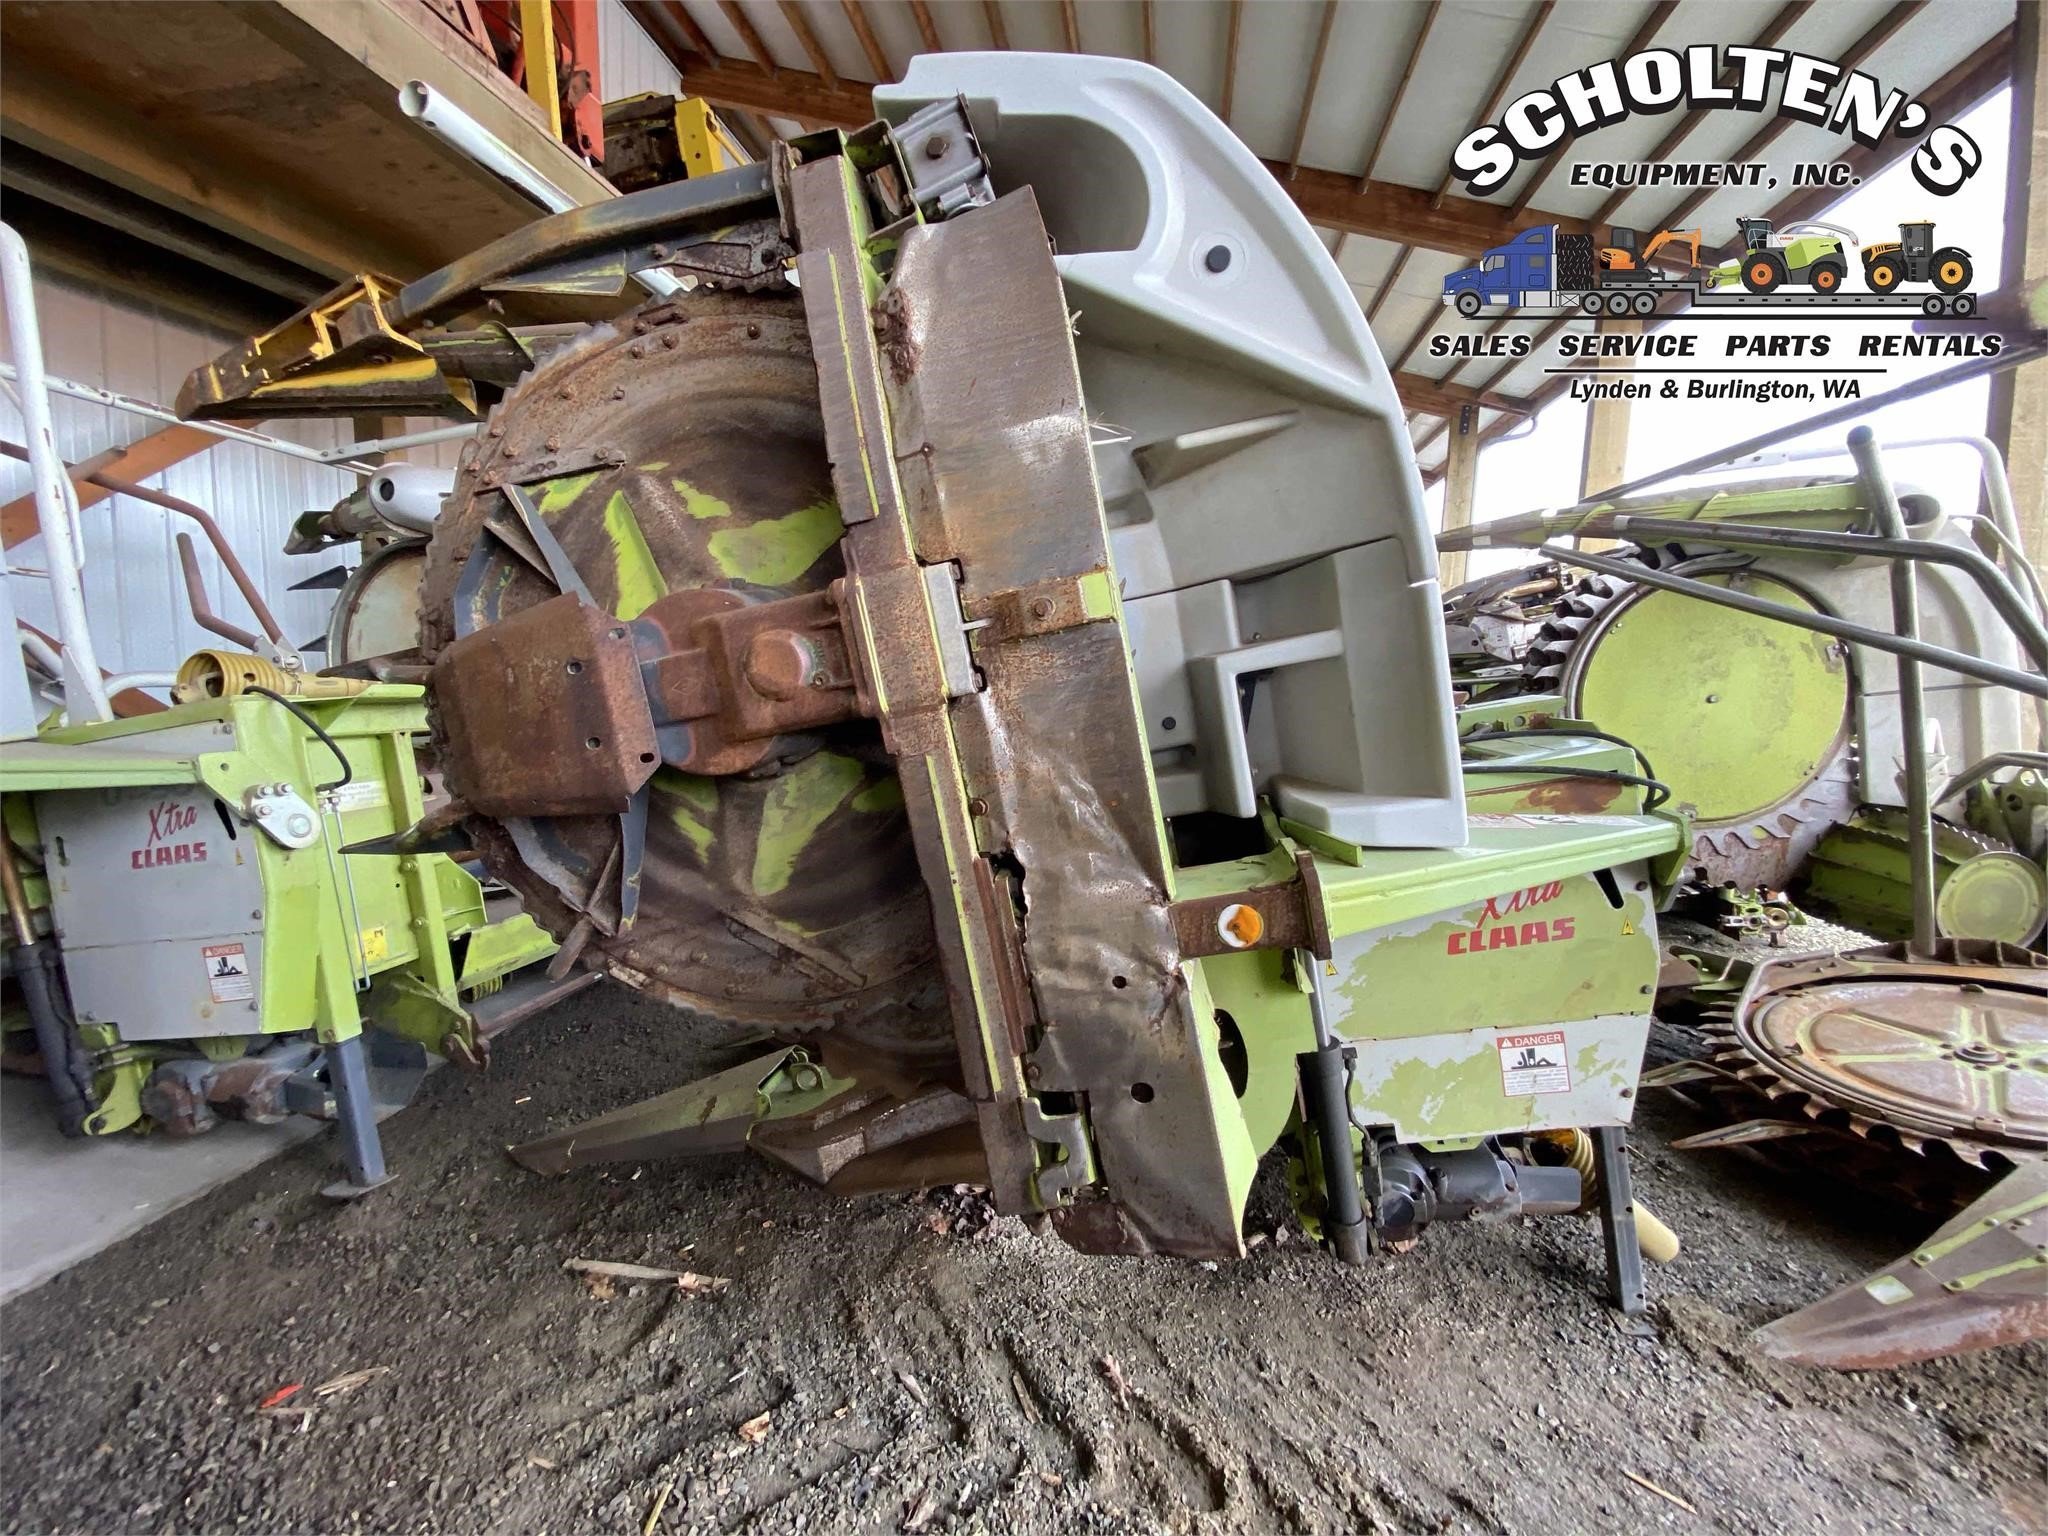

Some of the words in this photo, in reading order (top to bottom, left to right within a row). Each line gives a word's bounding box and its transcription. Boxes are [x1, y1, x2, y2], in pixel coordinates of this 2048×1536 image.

[148, 802, 197, 847] Xtra
[131, 842, 207, 869] CLAAS
[1447, 917, 1575, 955] CLAAS
[1514, 1034, 1562, 1047] DANGER
